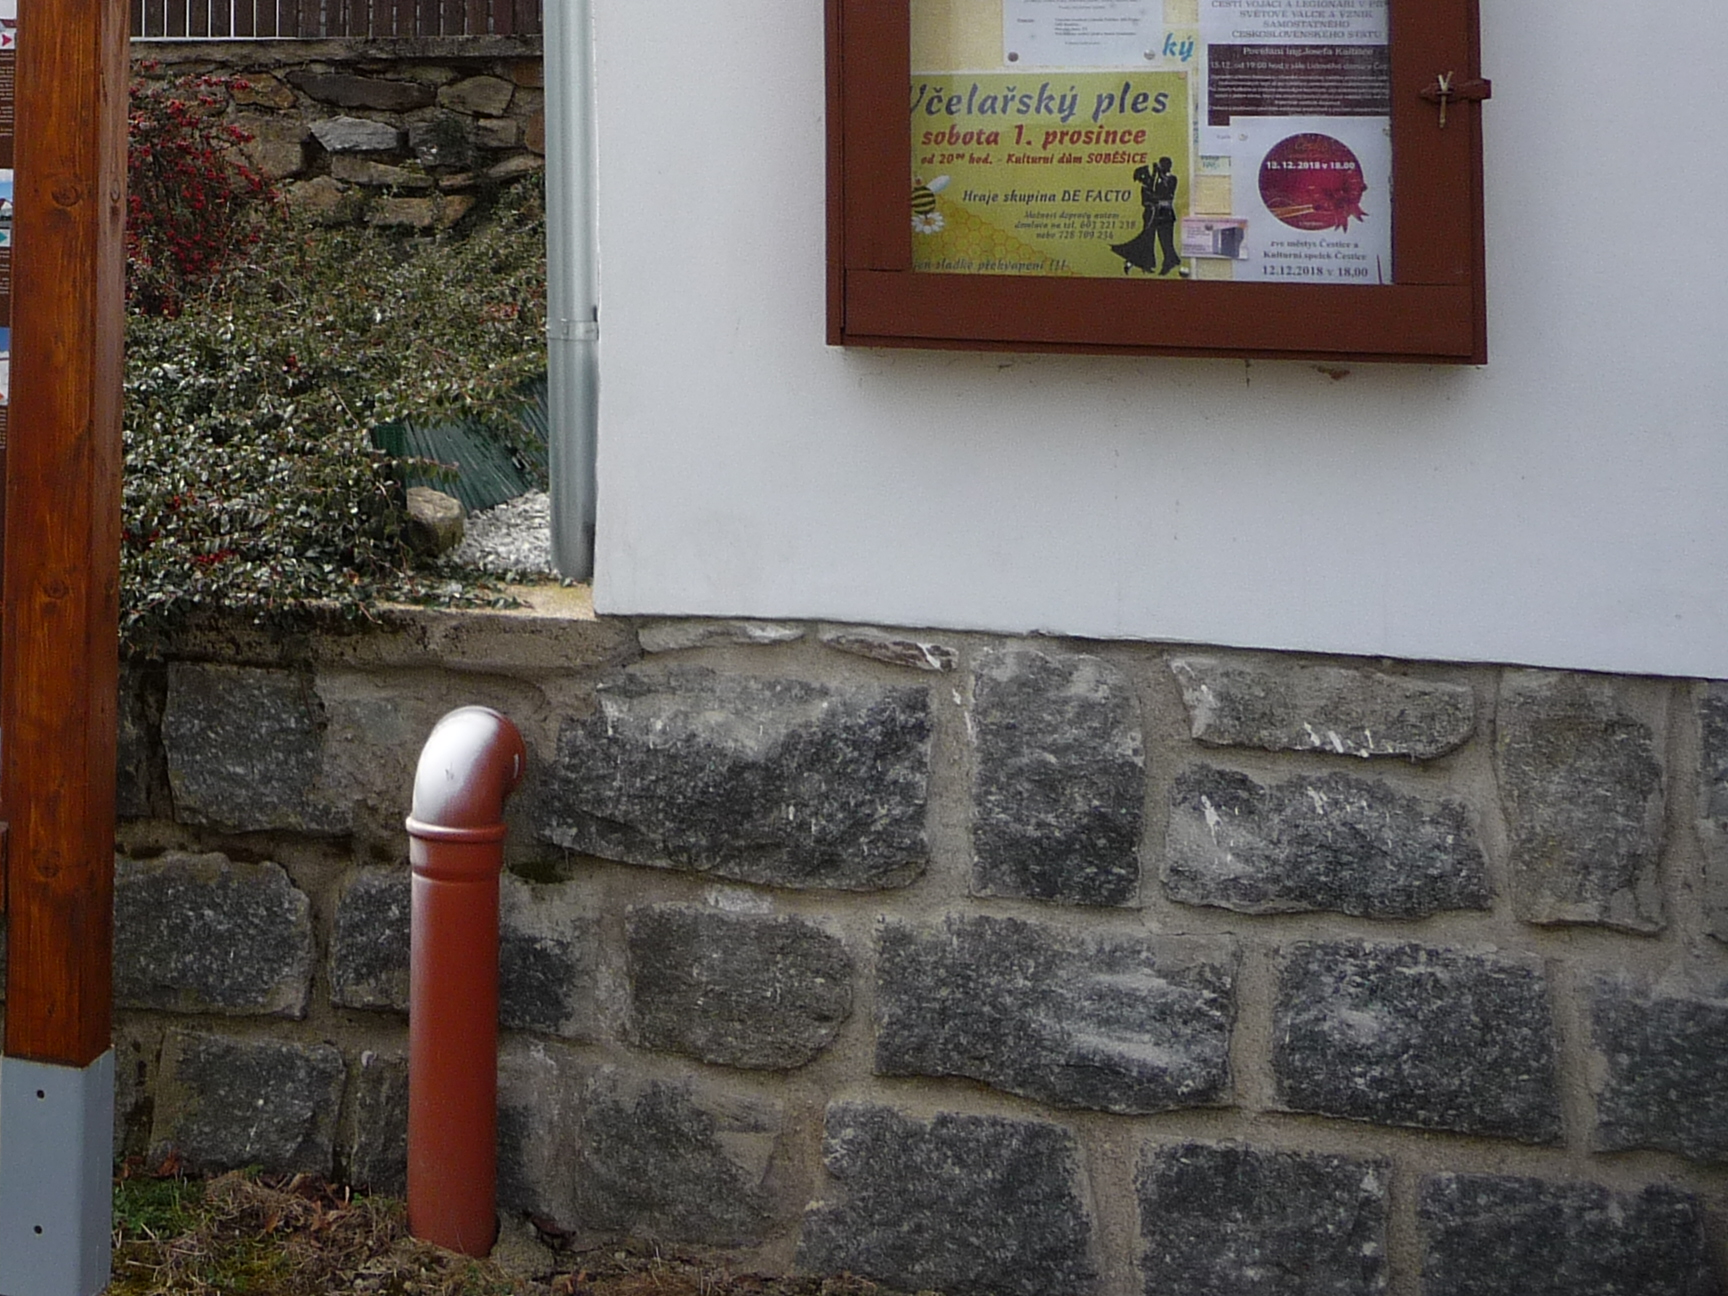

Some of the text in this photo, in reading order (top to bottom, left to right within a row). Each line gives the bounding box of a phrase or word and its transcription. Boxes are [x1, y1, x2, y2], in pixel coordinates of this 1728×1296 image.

[1092, 81, 1170, 123] ples
[921, 124, 1147, 151] sobota 1. prosince
[921, 153, 935, 165] od
[968, 153, 993, 165] hod.
[1006, 152, 1054, 165] Kulturní
[1057, 152, 1083, 165] dům
[1086, 150, 1148, 164] SOBĚŠICE
[962, 189, 1132, 206] Hraje skupina DE FACTO
[1036, 231, 1056, 240] nebo
[1319, 238, 1351, 248] Čestice
[1263, 250, 1367, 261] Kulturní spolek Čestice
